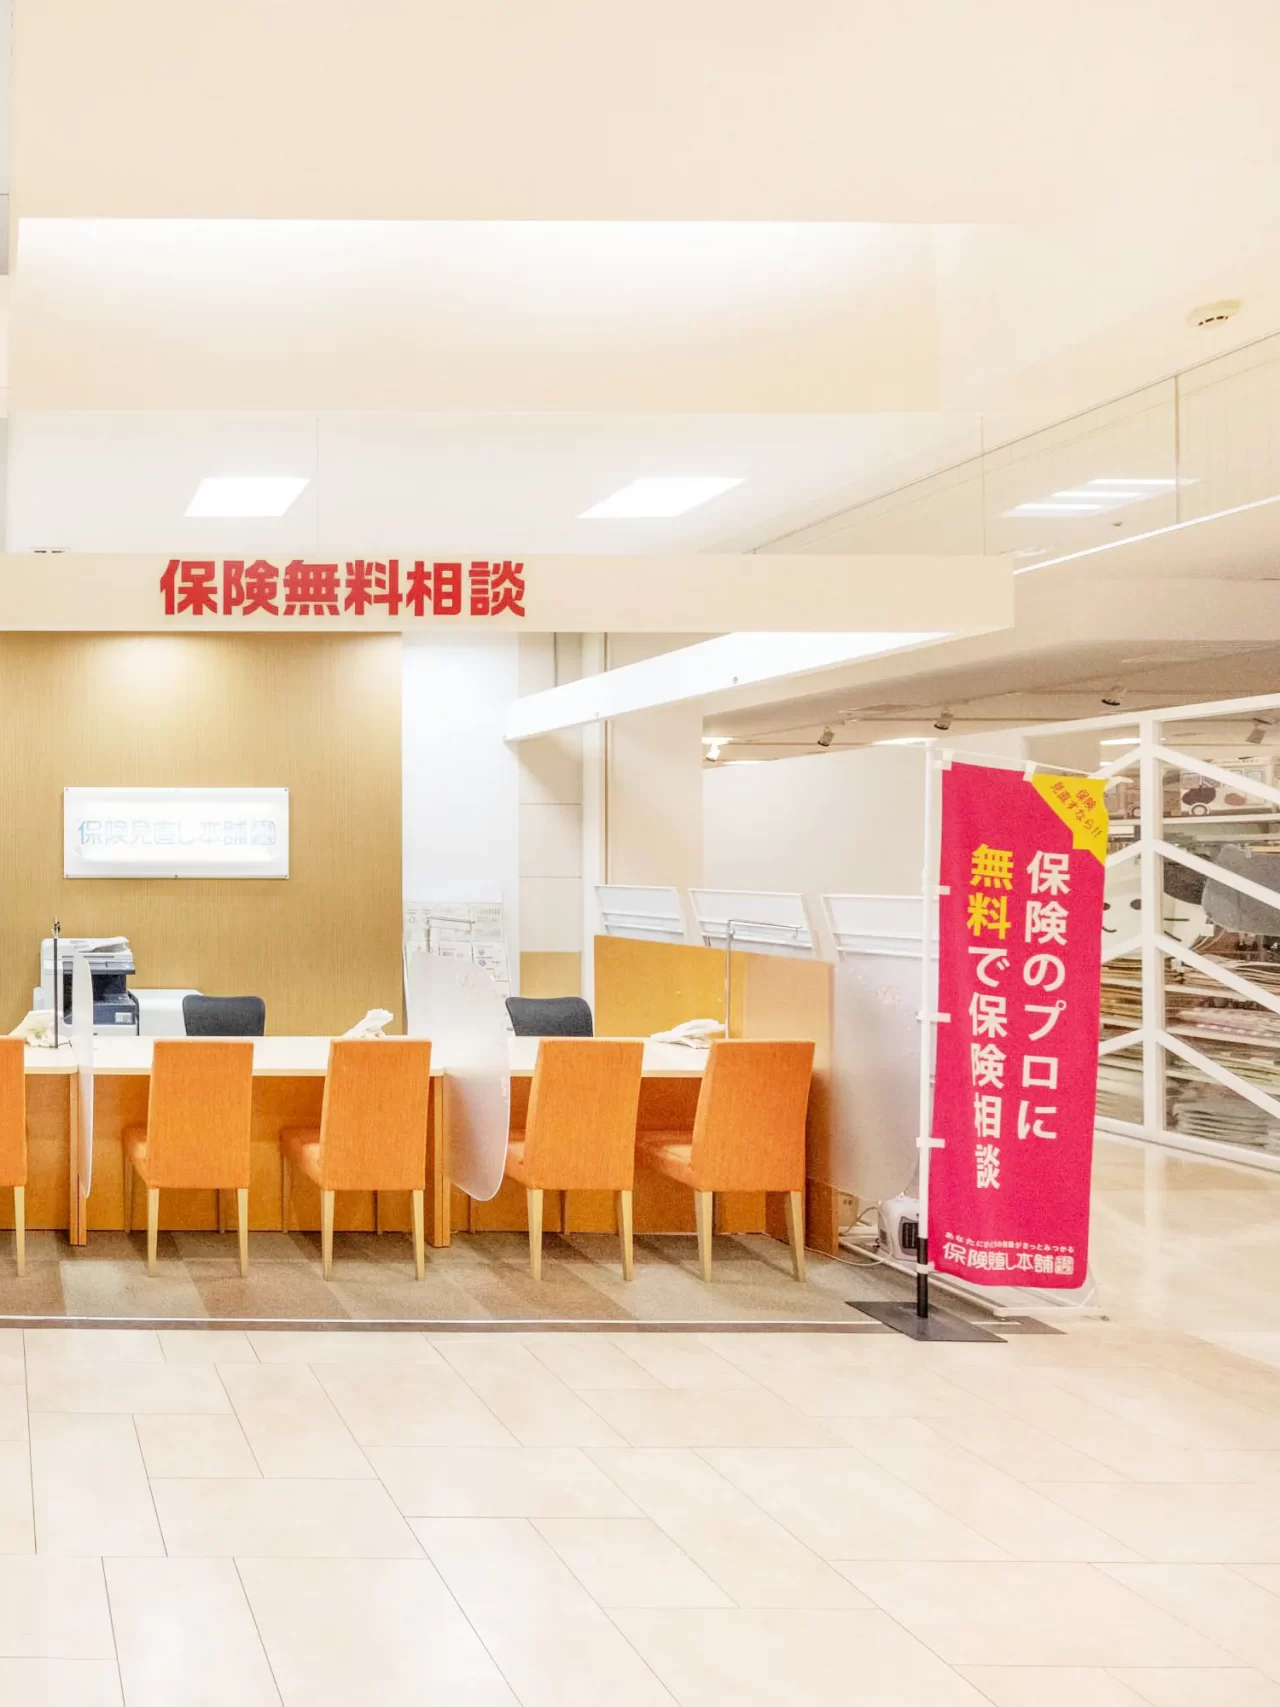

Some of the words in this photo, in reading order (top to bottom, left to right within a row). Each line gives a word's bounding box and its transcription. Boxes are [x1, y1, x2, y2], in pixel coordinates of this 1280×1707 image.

[159, 559, 526, 617] 保険無料相談
[1076, 789, 1096, 812] 保険
[78, 820, 248, 846] 保険見直し本舗
[966, 843, 1015, 1190] 無料で保険相談
[1017, 850, 1071, 1140] 保険のプロに
